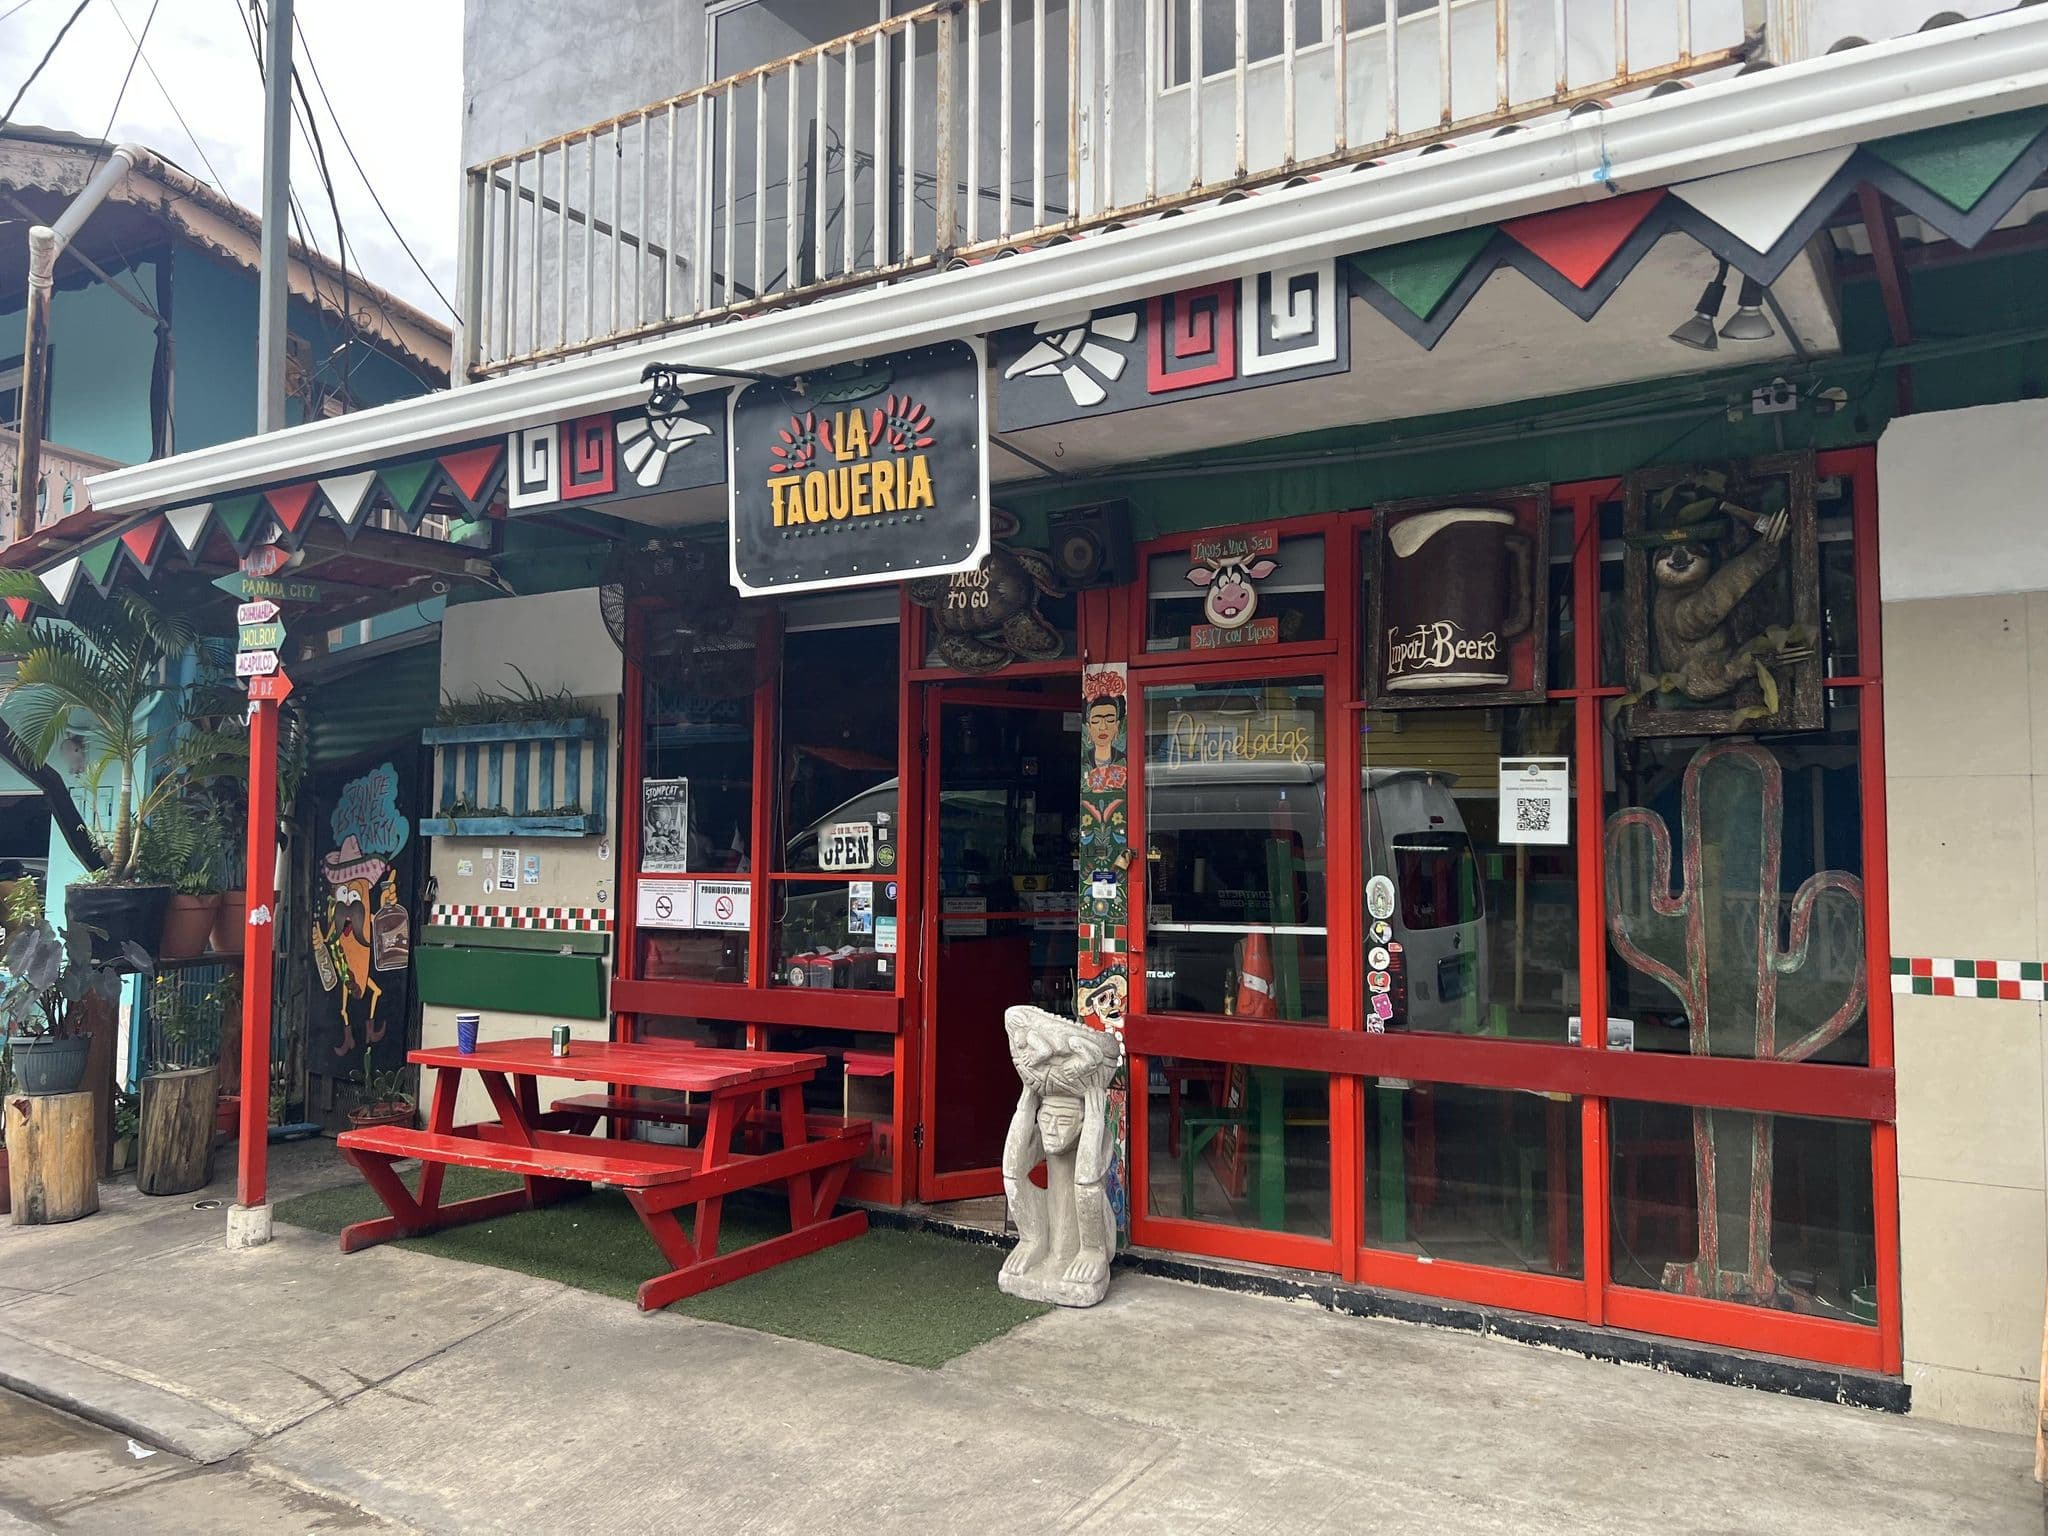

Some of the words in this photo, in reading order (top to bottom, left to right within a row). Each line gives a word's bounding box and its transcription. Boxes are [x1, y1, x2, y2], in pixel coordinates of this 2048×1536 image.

[833, 408, 870, 461] LA
[767, 455, 935, 527] TAQUERIA
[1193, 542, 1222, 561] TACOS
[949, 566, 990, 590] TACOS
[242, 579, 285, 598] PANAMA
[289, 584, 316, 598] CITY
[948, 591, 967, 609] TO
[971, 590, 989, 608] GO
[240, 604, 275, 622] CHIHUAHUA
[242, 628, 277, 647] HOLBOX
[1246, 622, 1275, 644] TACOS
[1386, 624, 1434, 675] Import
[1430, 620, 1501, 669] Beers
[239, 654, 273, 673] ACAPULCO
[1169, 713, 1310, 770] Micheladas
[823, 835, 870, 866] OPEN
[701, 885, 731, 895] PROHIBIDO
